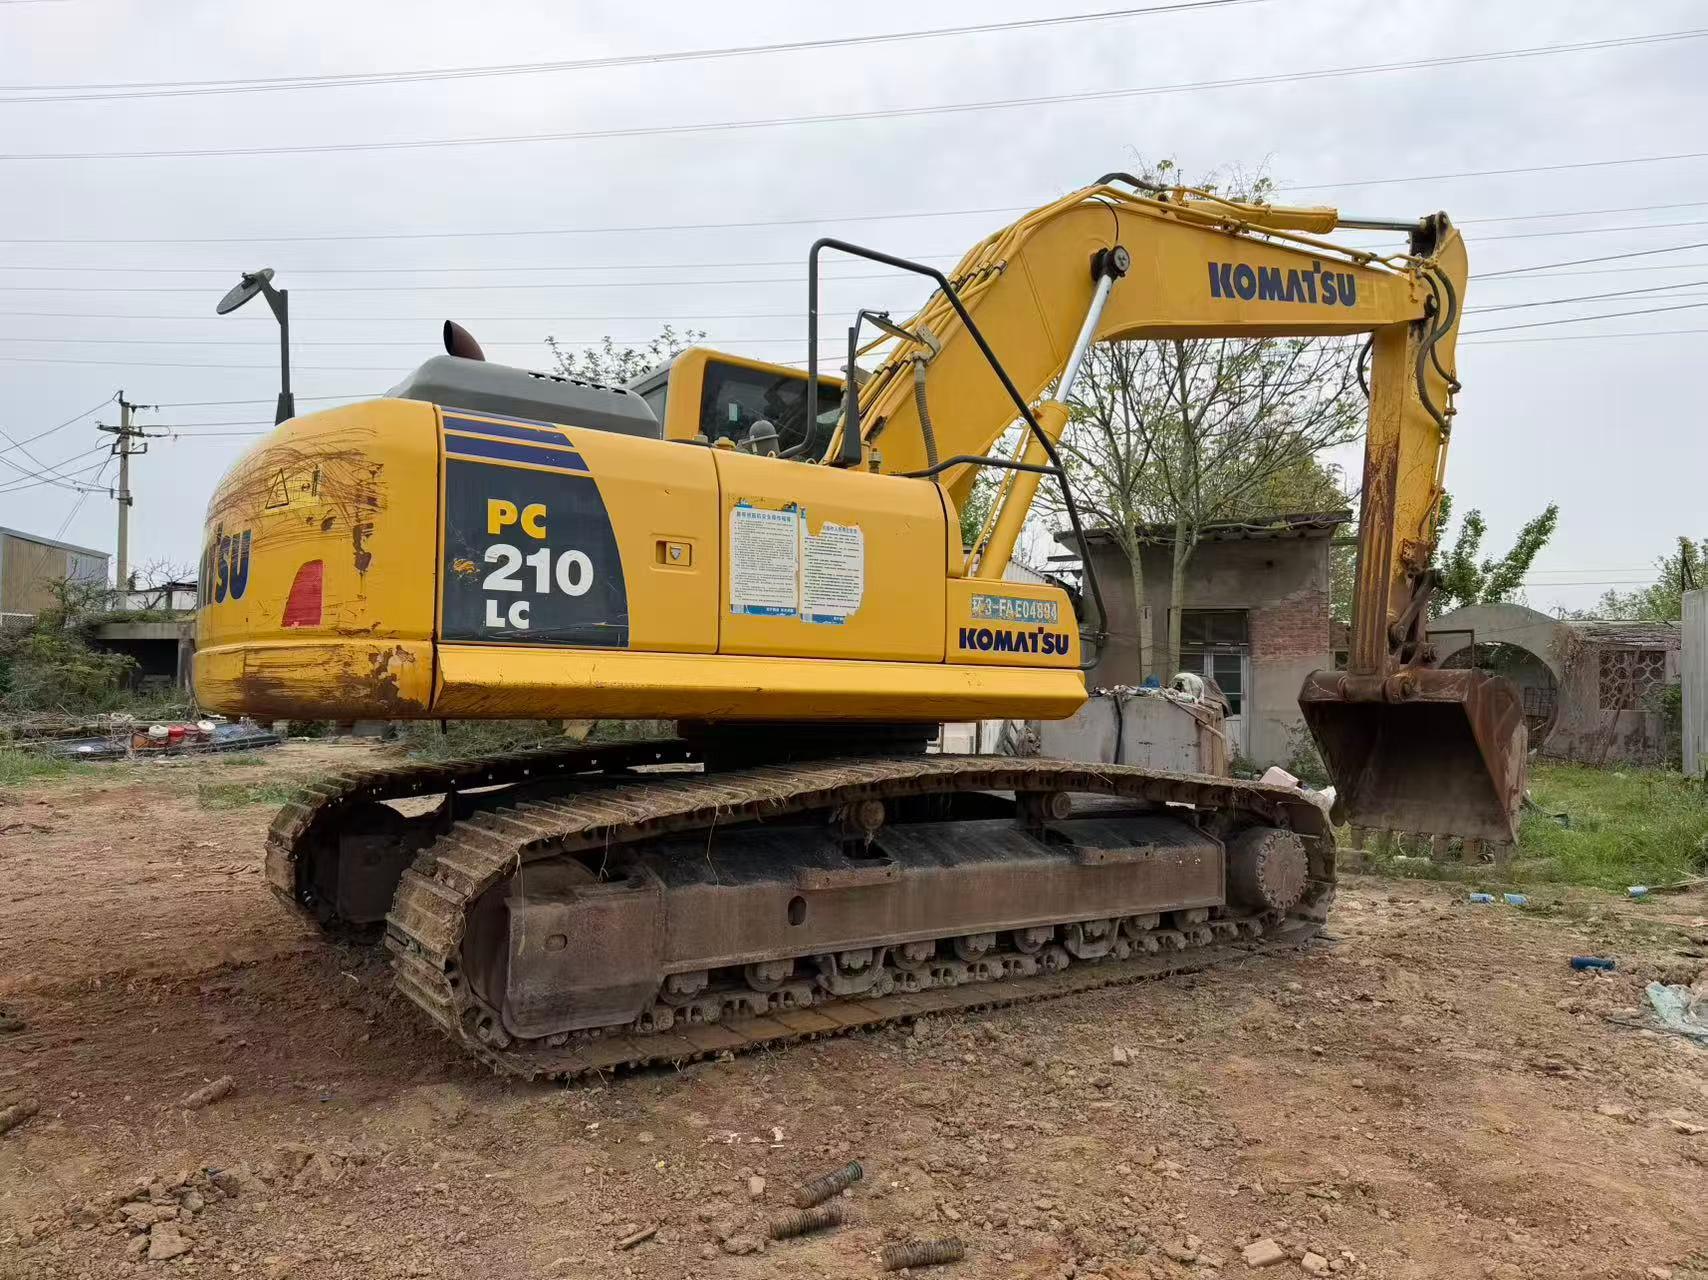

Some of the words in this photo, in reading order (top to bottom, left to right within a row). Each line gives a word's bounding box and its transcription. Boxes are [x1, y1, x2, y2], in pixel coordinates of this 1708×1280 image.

[1208, 260, 1356, 306] KOMATSU
[487, 498, 547, 540] PC
[482, 543, 594, 597] 210
[486, 599, 530, 630] LC
[959, 626, 1069, 655] KOMATSU
